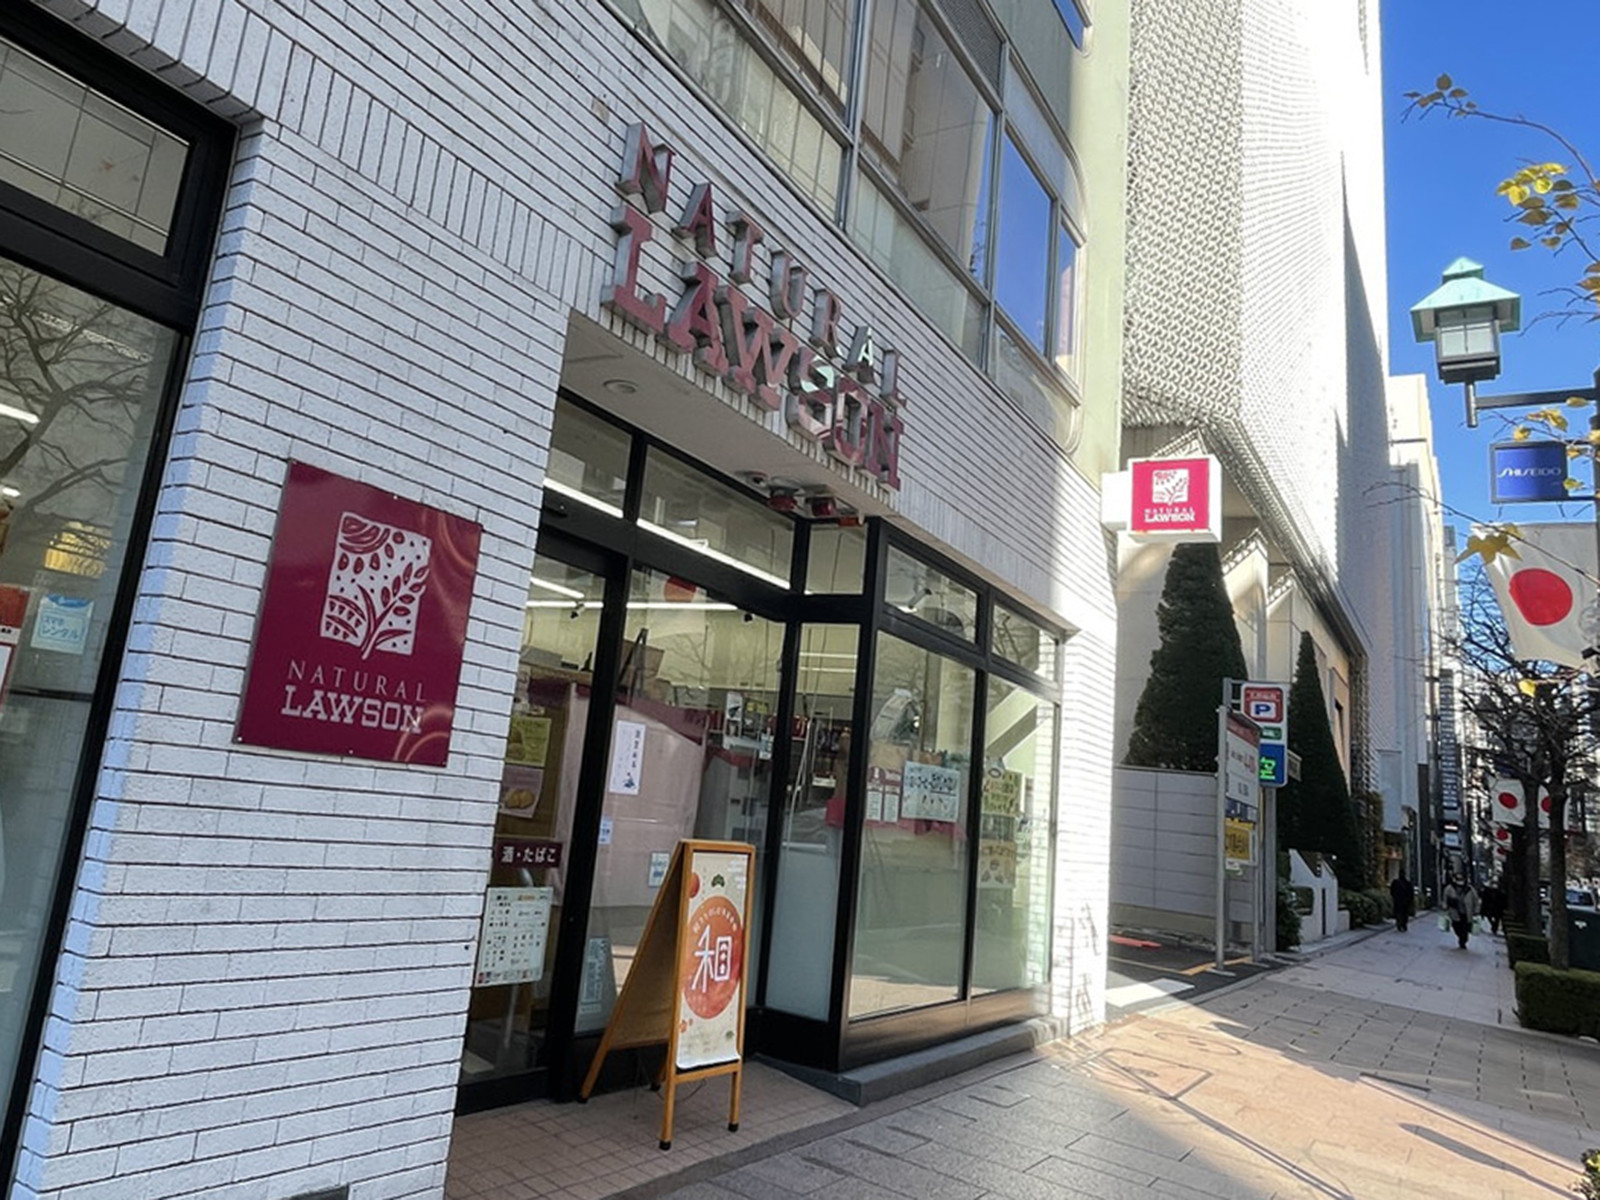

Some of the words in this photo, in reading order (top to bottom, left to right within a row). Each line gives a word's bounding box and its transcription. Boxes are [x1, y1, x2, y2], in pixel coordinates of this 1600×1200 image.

[615, 121, 906, 408] NATURAL
[601, 203, 905, 491] LAWSON
[1496, 466, 1562, 478] SHISEIDO
[1144, 512, 1195, 523] LAWSON
[288, 659, 426, 702] NATURAL
[281, 684, 424, 734] LAWSON
[1255, 704, 1271, 715] P
